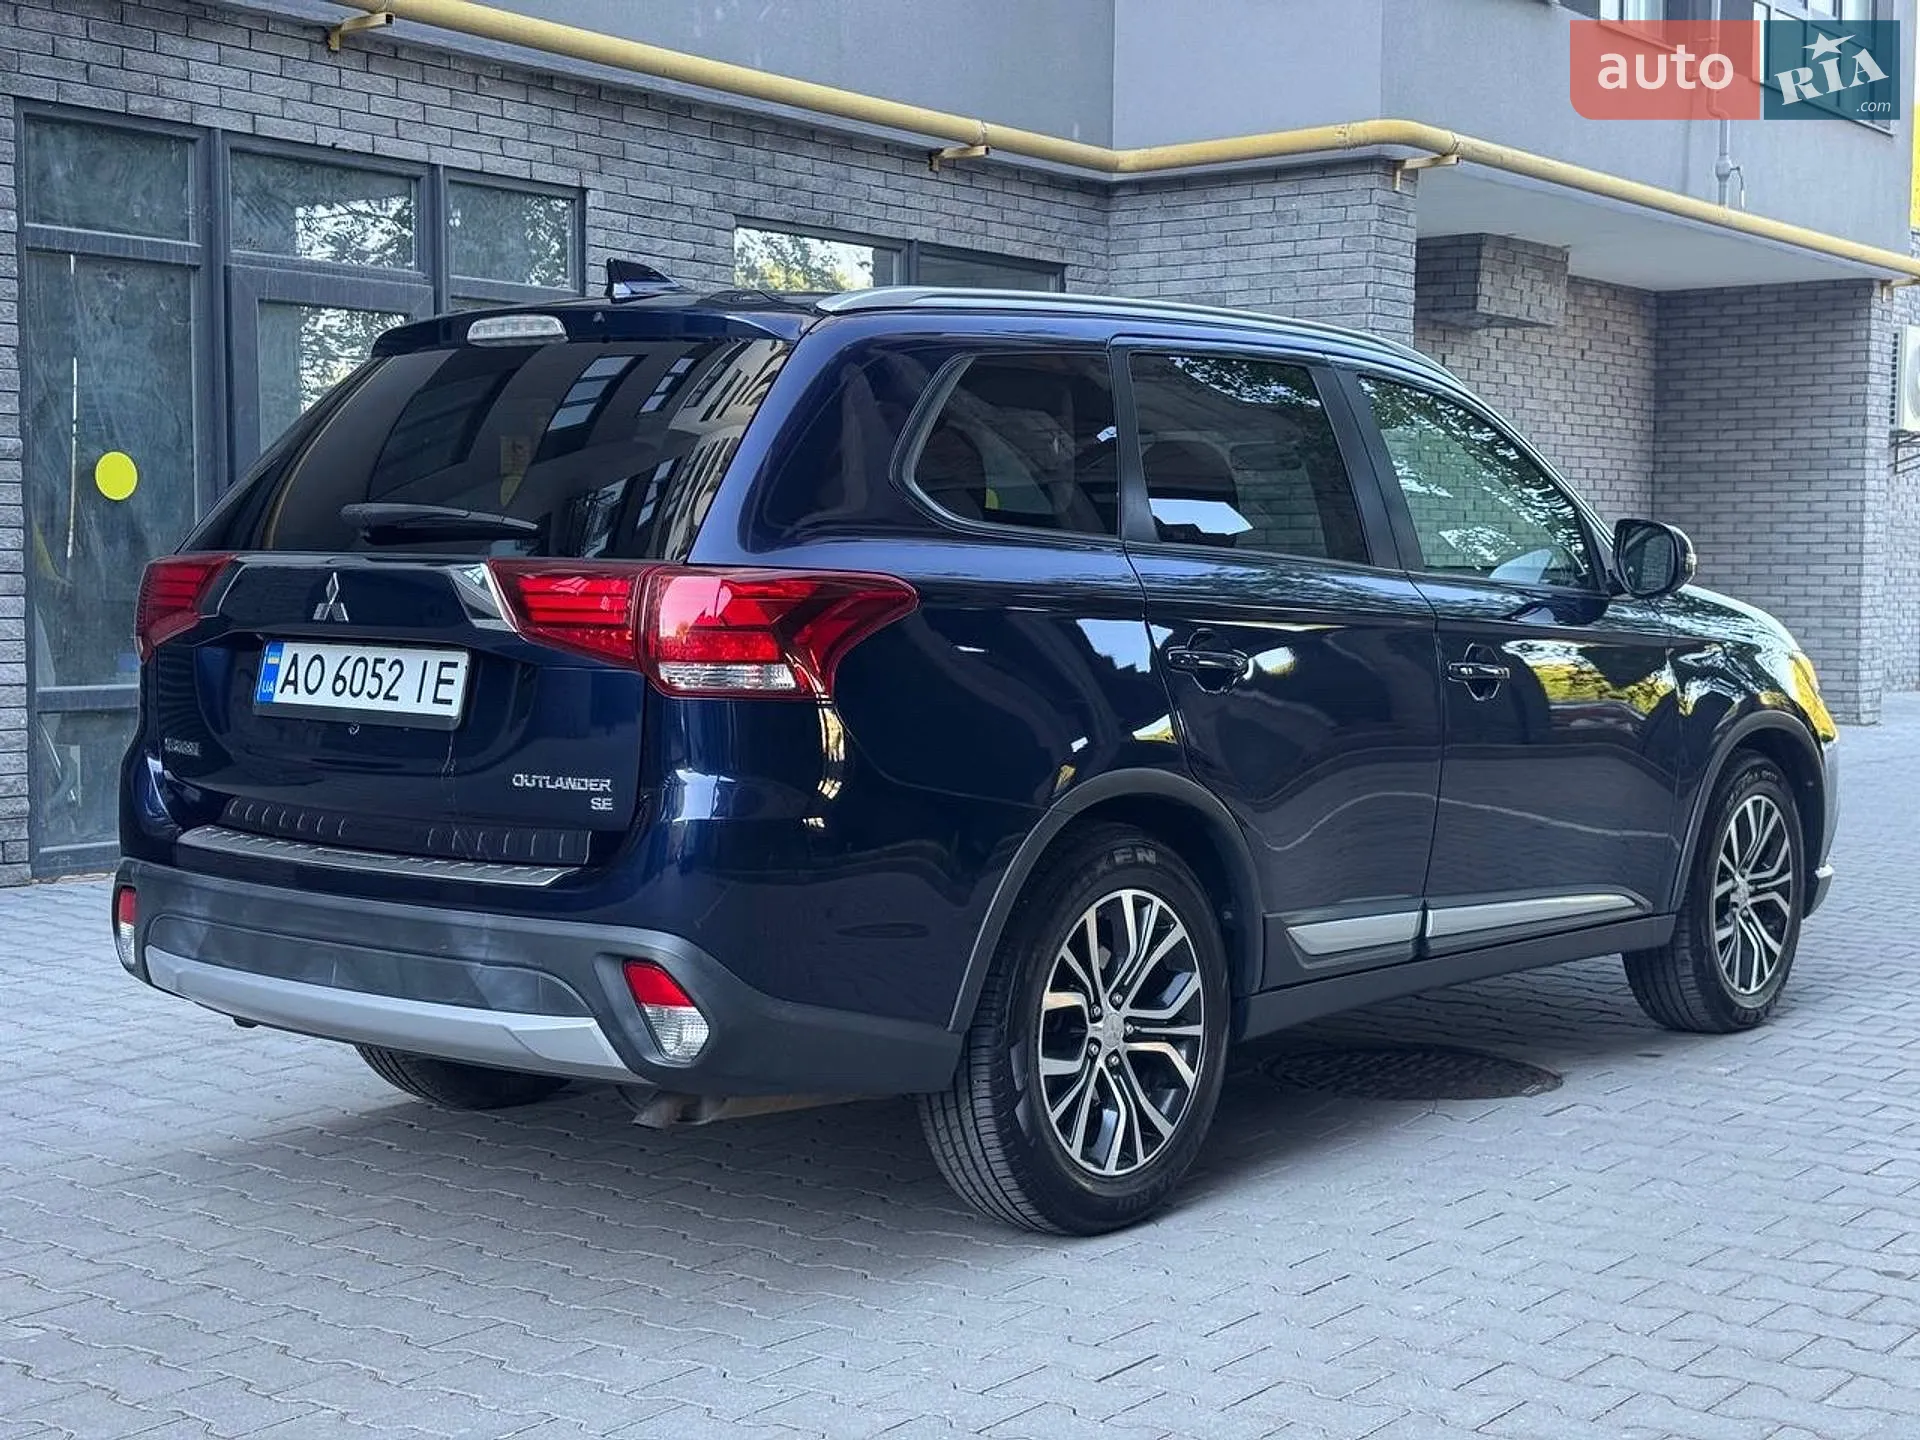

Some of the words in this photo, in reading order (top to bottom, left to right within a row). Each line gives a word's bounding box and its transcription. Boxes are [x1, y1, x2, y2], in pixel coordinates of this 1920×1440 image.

[262, 680, 275, 694] UA
[279, 653, 325, 696] AO
[332, 655, 404, 701] 6052
[416, 660, 459, 705] IE
[512, 773, 612, 792] OUTLANDER
[590, 797, 613, 811] SE
